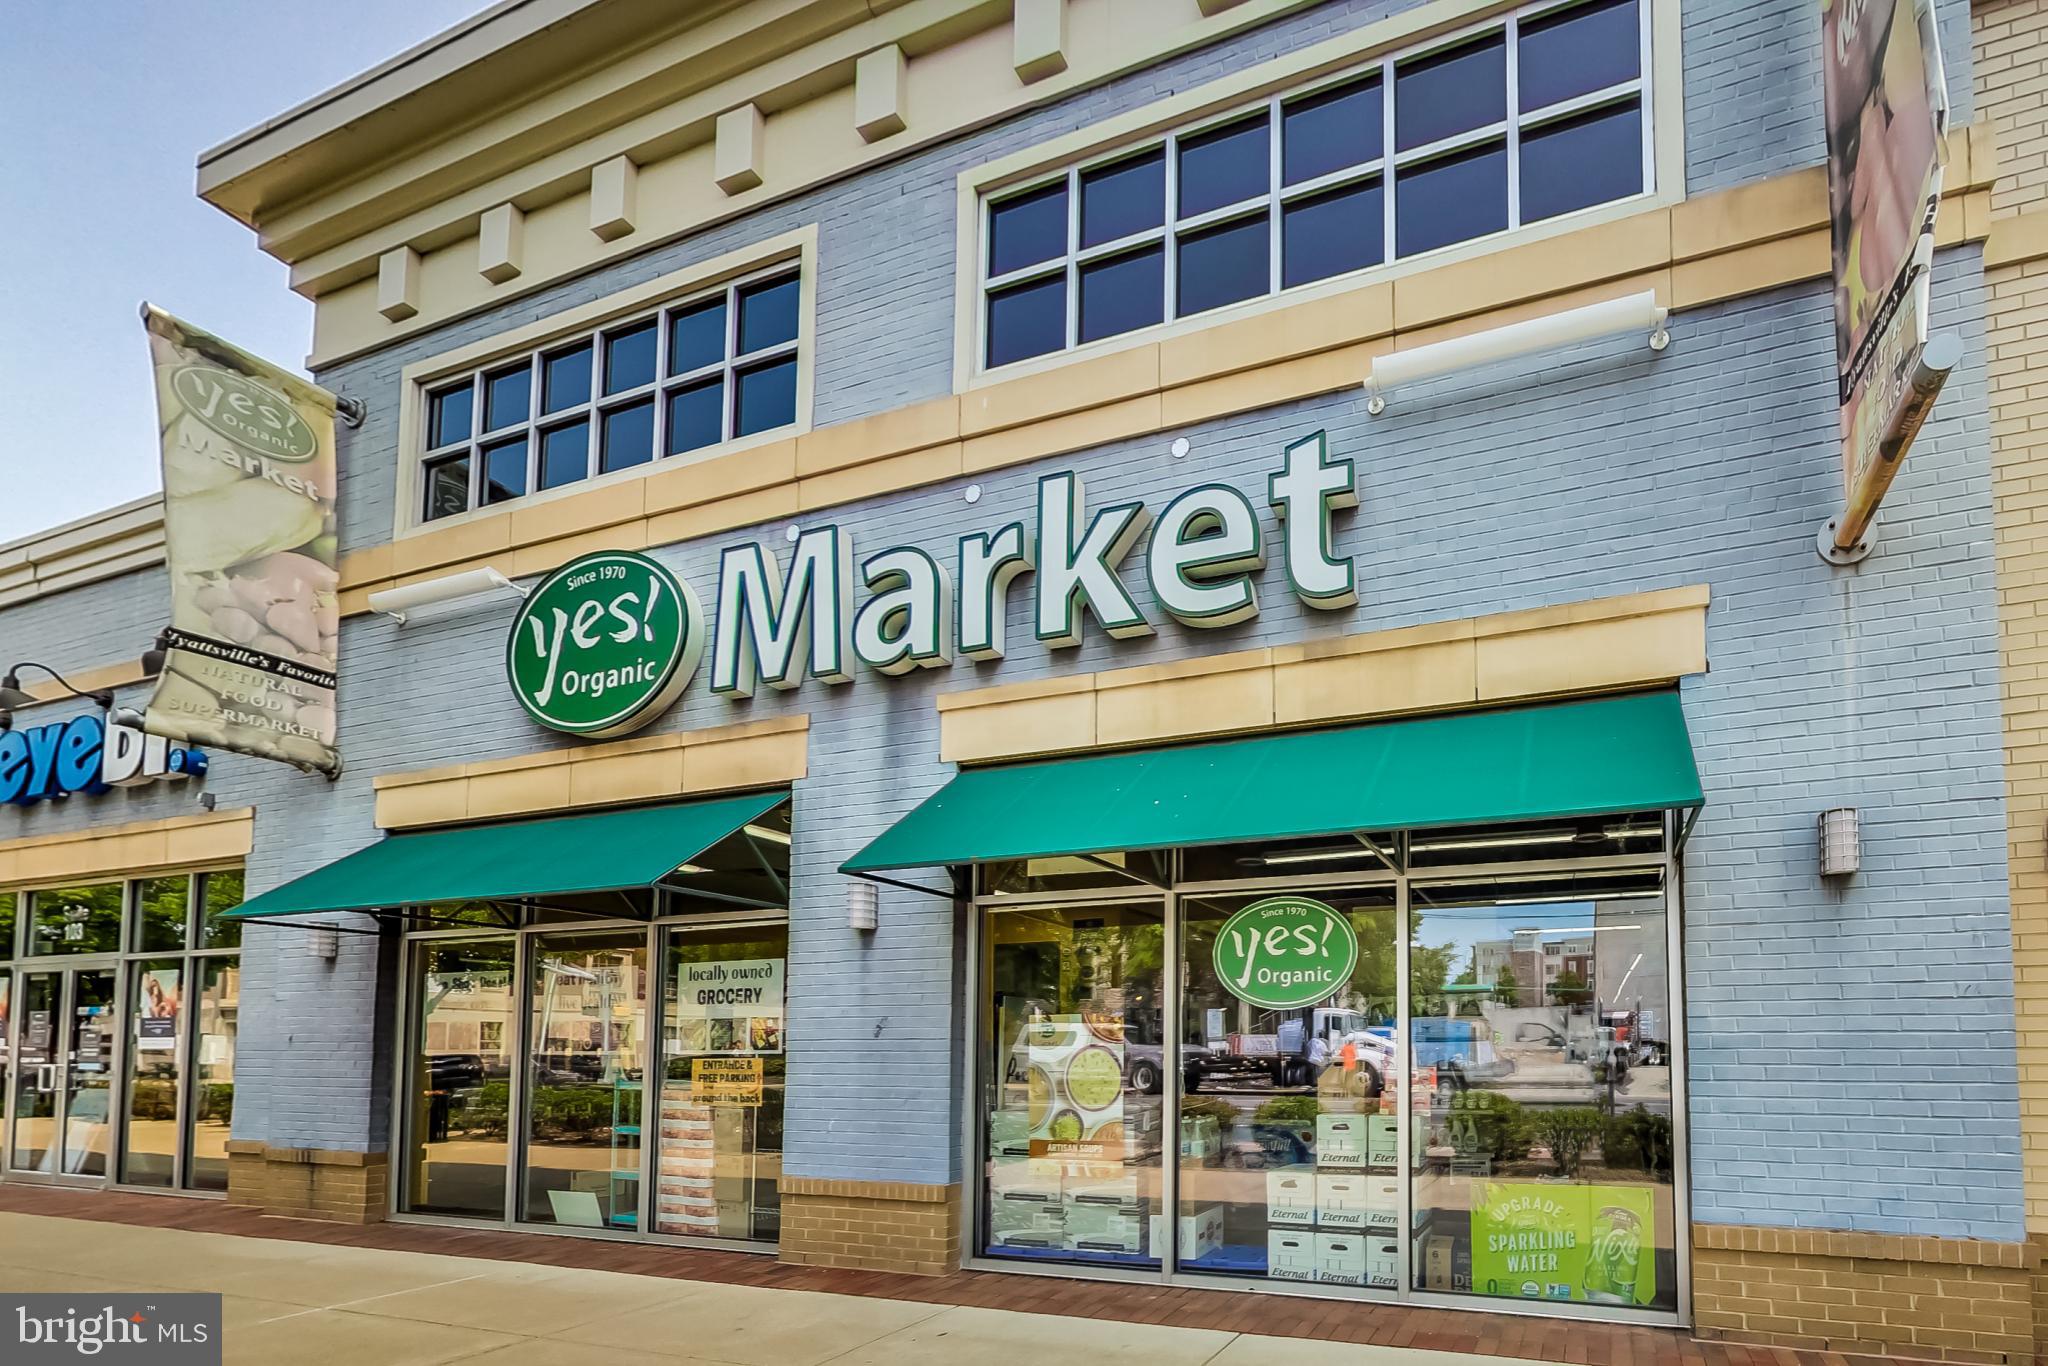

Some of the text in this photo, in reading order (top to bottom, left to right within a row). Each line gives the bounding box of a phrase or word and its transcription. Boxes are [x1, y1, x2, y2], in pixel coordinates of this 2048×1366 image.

[222, 413, 298, 454] Organic
[179, 412, 320, 502] Market
[710, 429, 1358, 698] Market
[567, 566, 626, 591] Since 1970
[202, 664, 303, 697] NATURAL
[561, 657, 656, 698] Organic
[221, 690, 283, 711] FOOD
[168, 698, 324, 740] SUPERMARKET
[1261, 907, 1307, 919] Since 1970
[688, 963, 773, 984] locally owned
[1257, 966, 1332, 987] Organic
[697, 988, 763, 1005] GROCERY
[702, 1060, 745, 1070] ENTRANCE
[698, 1073, 756, 1083] FREE PARKING
[740, 1092, 760, 1104] back
[1047, 1143, 1079, 1153] ARTISAN
[1321, 1153, 1361, 1163] Eternal
[1271, 1209, 1309, 1220] Eternal
[1321, 1212, 1361, 1223] Eternal
[1492, 1196, 1565, 1222] UPGRADE
[1488, 1230, 1576, 1252] SPARKLING
[1271, 1267, 1309, 1279] Eternal
[1507, 1253, 1559, 1273] WATER
[1320, 1271, 1360, 1284] Eternal
